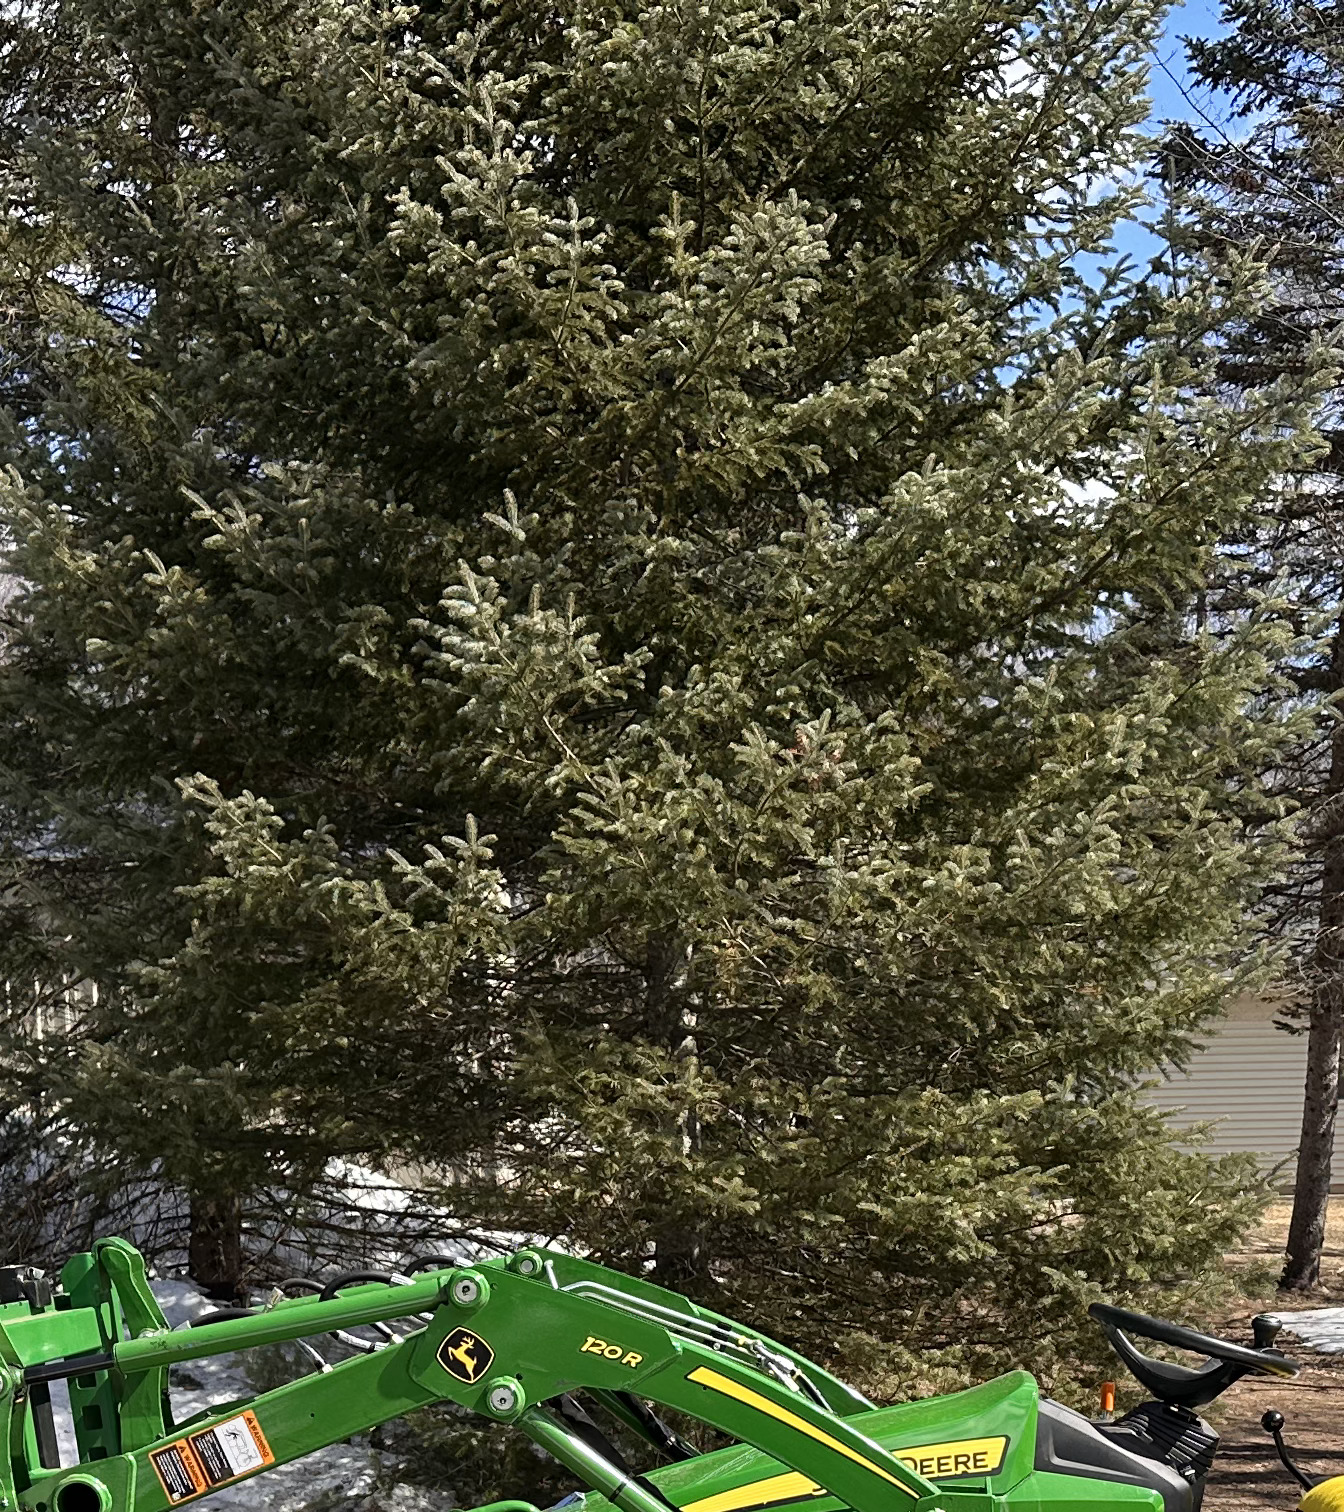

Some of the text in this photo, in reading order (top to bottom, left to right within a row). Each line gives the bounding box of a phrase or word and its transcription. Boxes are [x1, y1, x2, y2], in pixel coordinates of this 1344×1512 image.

[580, 1336, 643, 1368] 120 R
[250, 1425, 270, 1458] WARNING
[183, 1454, 203, 1488] WARNING
